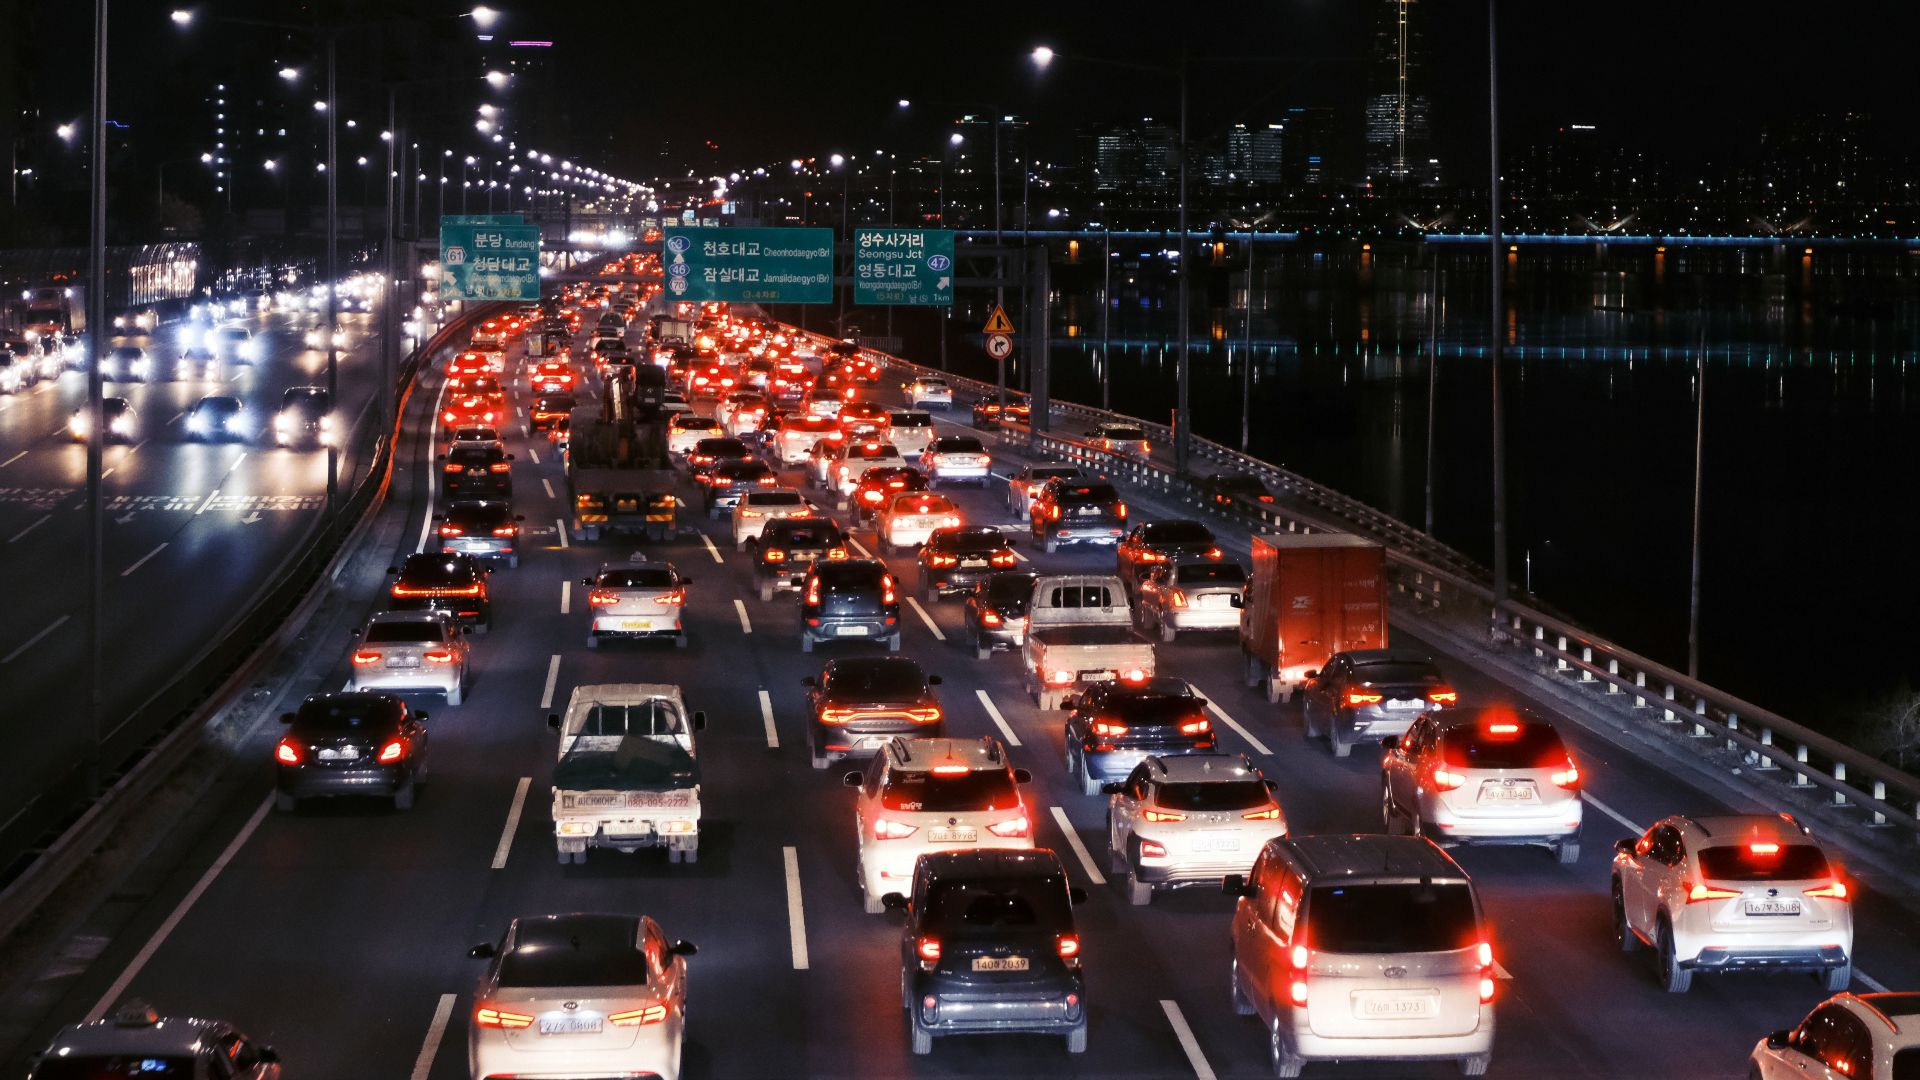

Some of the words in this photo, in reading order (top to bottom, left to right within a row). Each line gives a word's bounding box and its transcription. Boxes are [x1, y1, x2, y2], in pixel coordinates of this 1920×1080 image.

[475, 233, 503, 248] 분당
[505, 239, 535, 250] Bundang
[859, 233, 924, 248] 성수사거리
[703, 241, 760, 257] 천호대교
[858, 248, 904, 260] Seongsu
[905, 249, 922, 259] Jct
[449, 251, 462, 261] 61
[930, 257, 946, 268] 47
[473, 257, 531, 272] 청담대교
[673, 264, 686, 275] 46
[858, 263, 917, 278] 영동대교
[703, 267, 760, 283] 잠실대교
[673, 281, 685, 290] 70
[1774, 903, 1798, 912] 3508
